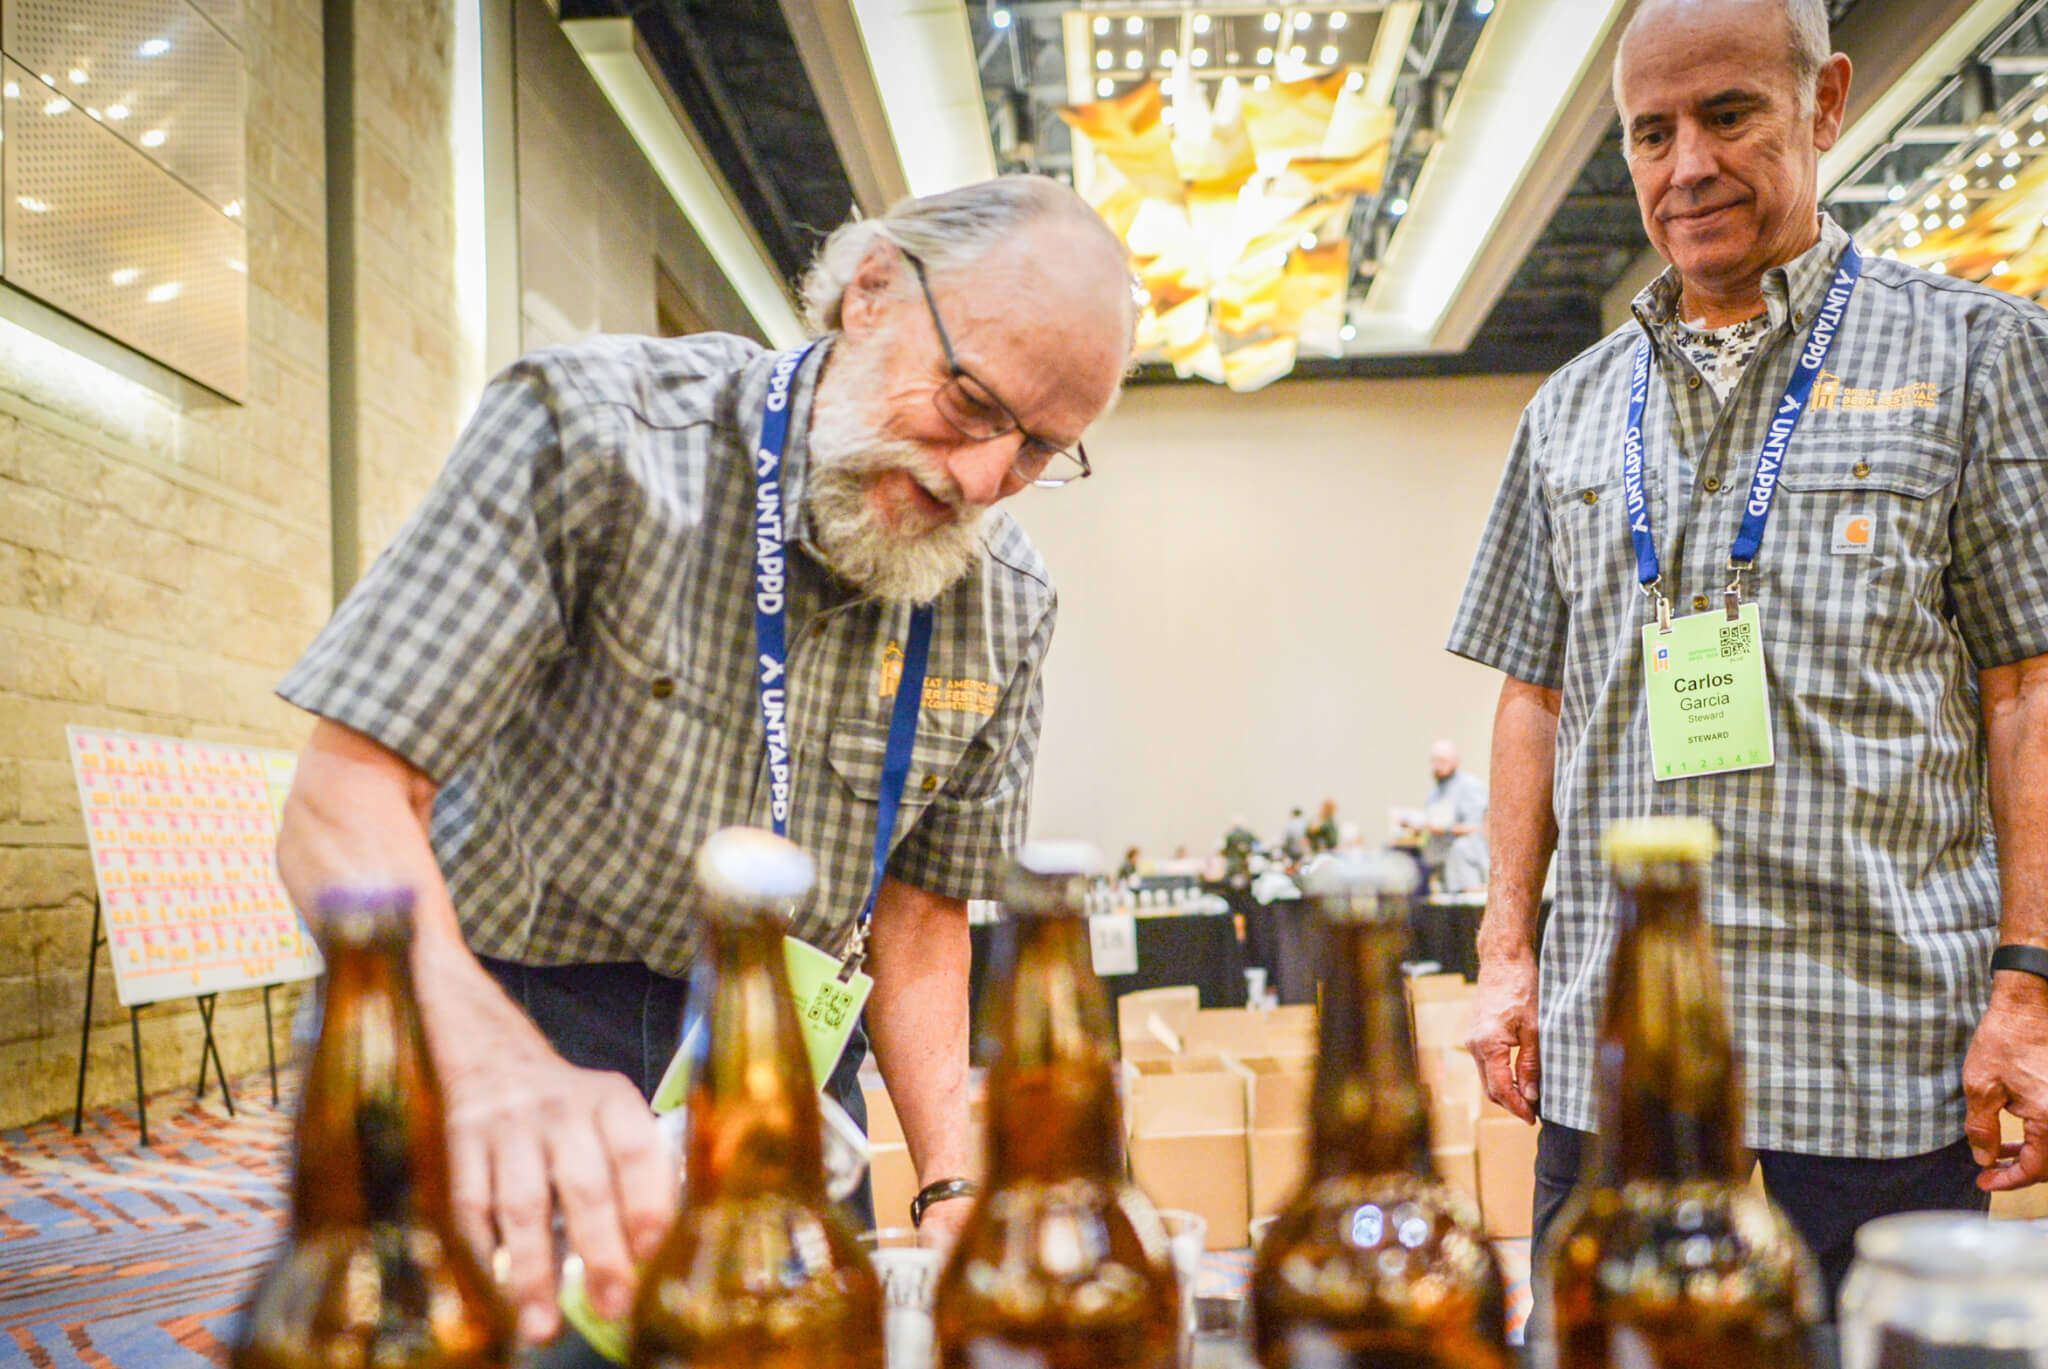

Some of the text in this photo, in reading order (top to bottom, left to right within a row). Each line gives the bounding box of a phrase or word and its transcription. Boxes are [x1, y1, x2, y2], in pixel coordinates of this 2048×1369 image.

[1801, 287, 1851, 370] UNTAPPD
[1624, 426, 1643, 514] UNTAPPD
[1748, 414, 1794, 516] UNTAPPD
[756, 481, 785, 614] UNTAPPD
[1674, 673, 1733, 693] Carlos
[1680, 692, 1730, 711] Garcia
[1688, 711, 1724, 723] Steward
[761, 689, 789, 821] UNTAPPD
[1688, 731, 1729, 744] STEWARD
